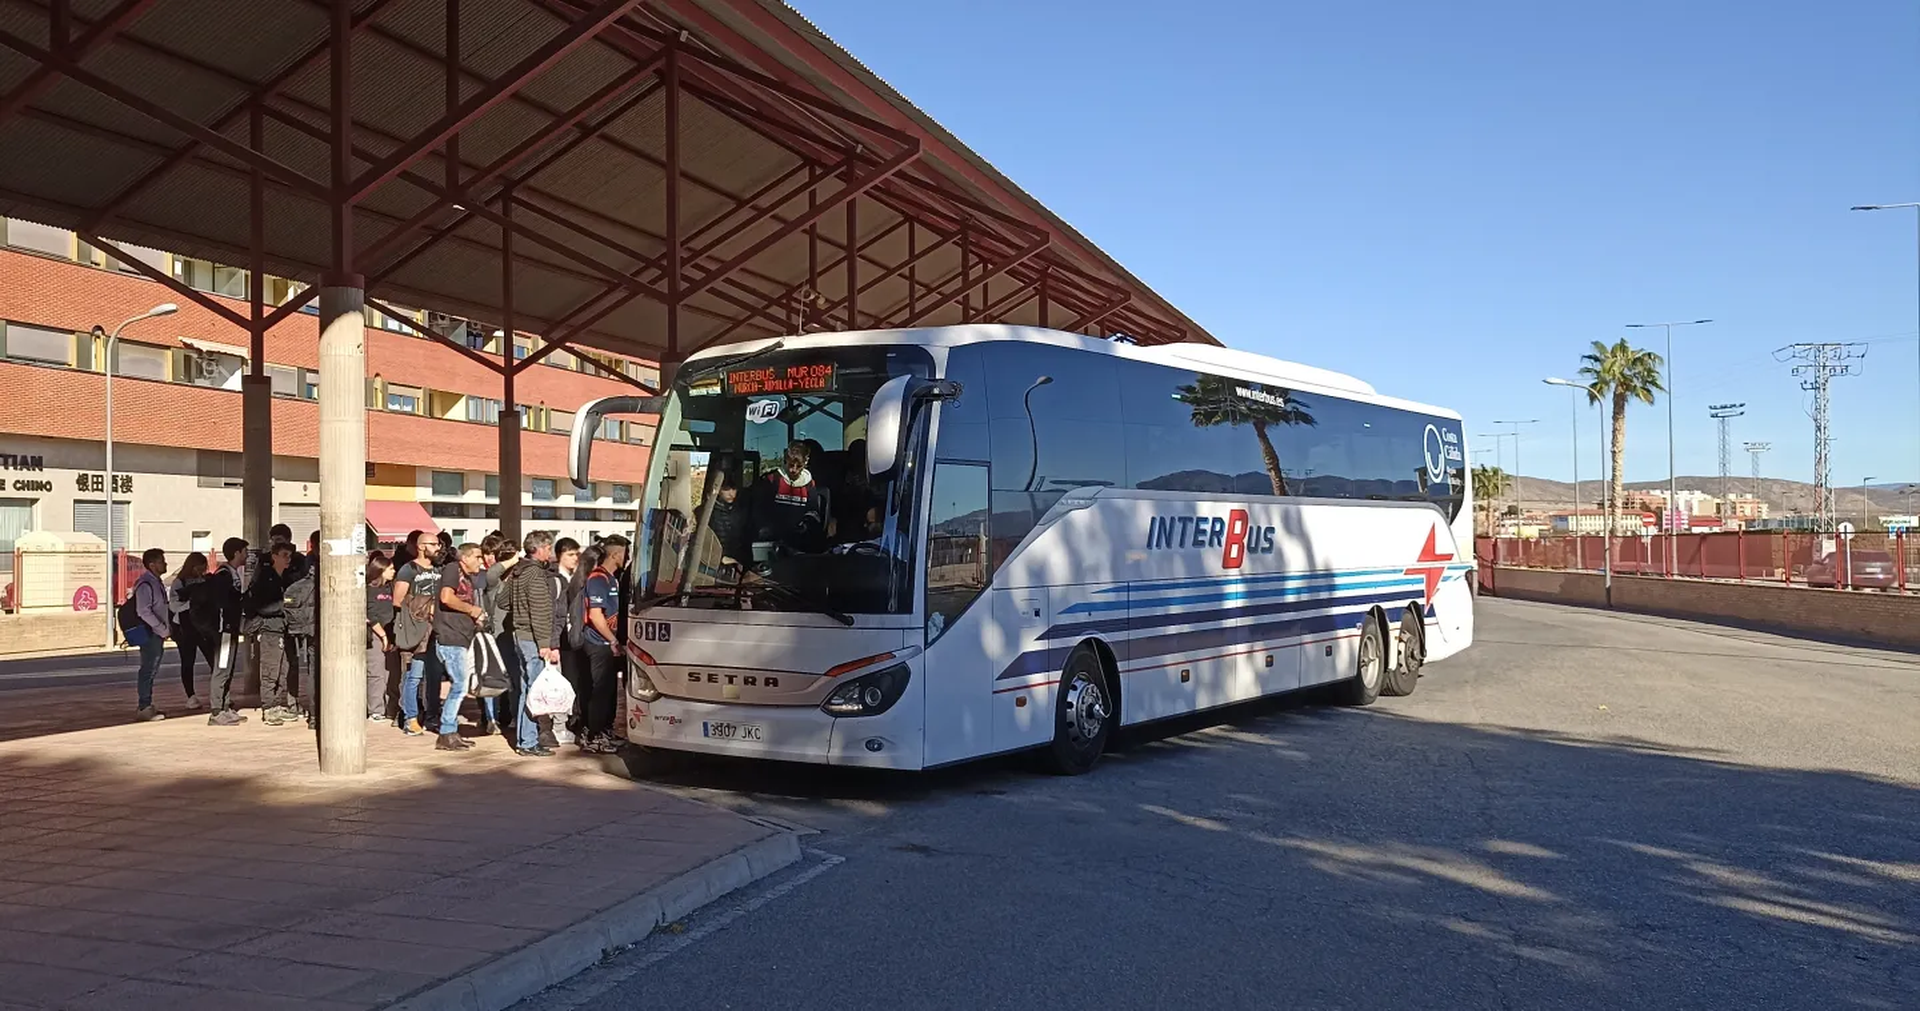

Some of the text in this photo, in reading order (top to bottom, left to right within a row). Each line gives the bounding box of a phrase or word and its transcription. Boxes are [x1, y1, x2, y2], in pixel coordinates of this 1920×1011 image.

[728, 368, 775, 384] INTERBUS
[810, 364, 832, 377] 084
[0, 453, 43, 472] TIAN
[12, 479, 53, 493] CHINO
[1146, 509, 1275, 569] INTERBUS
[687, 671, 779, 687] SETRA
[710, 724, 761, 740] 3907 JKC
